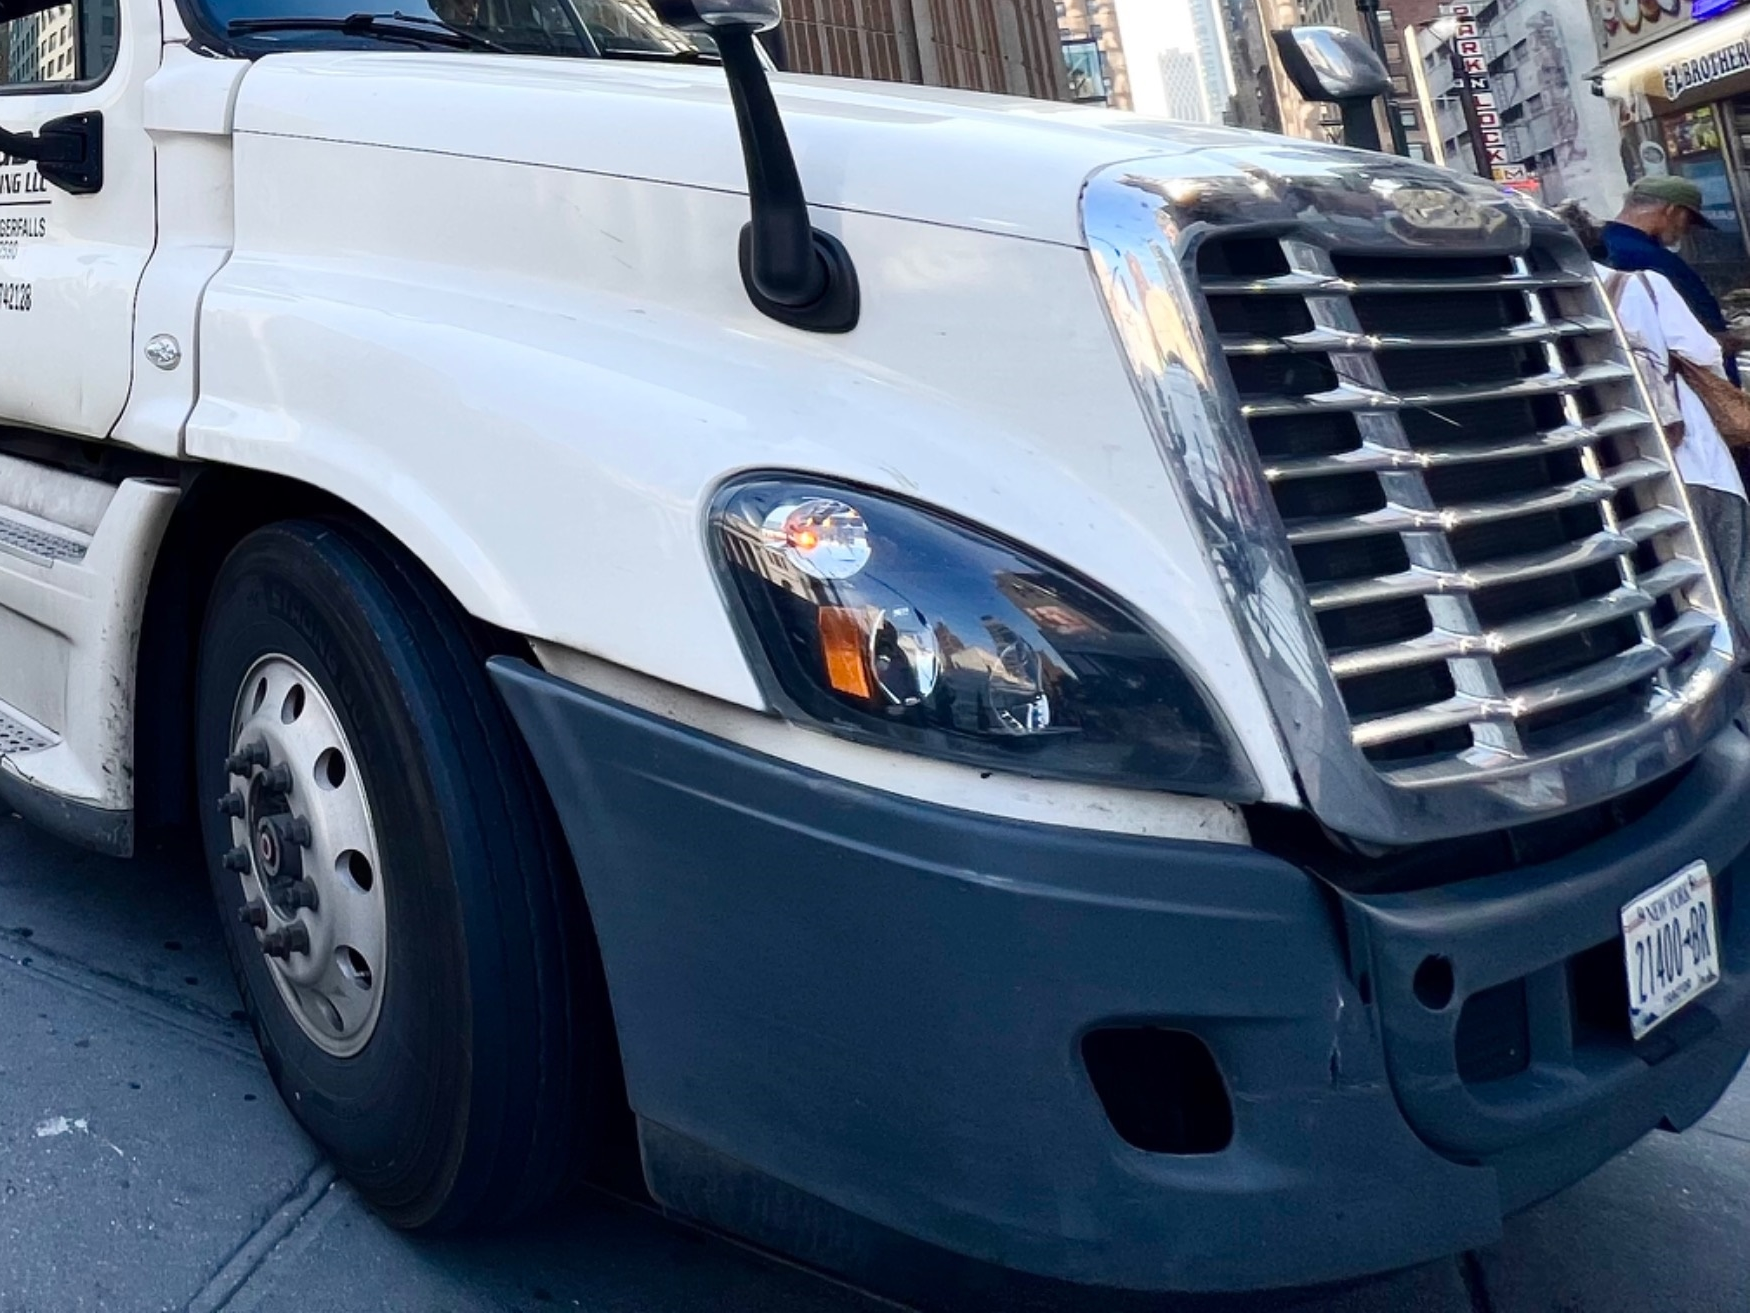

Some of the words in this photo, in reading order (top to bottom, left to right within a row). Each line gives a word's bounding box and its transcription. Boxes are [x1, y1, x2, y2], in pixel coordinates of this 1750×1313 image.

[1453, 6, 1482, 73] PARK
[1474, 95, 1505, 164] LOCK
[24, 171, 48, 193] LLC
